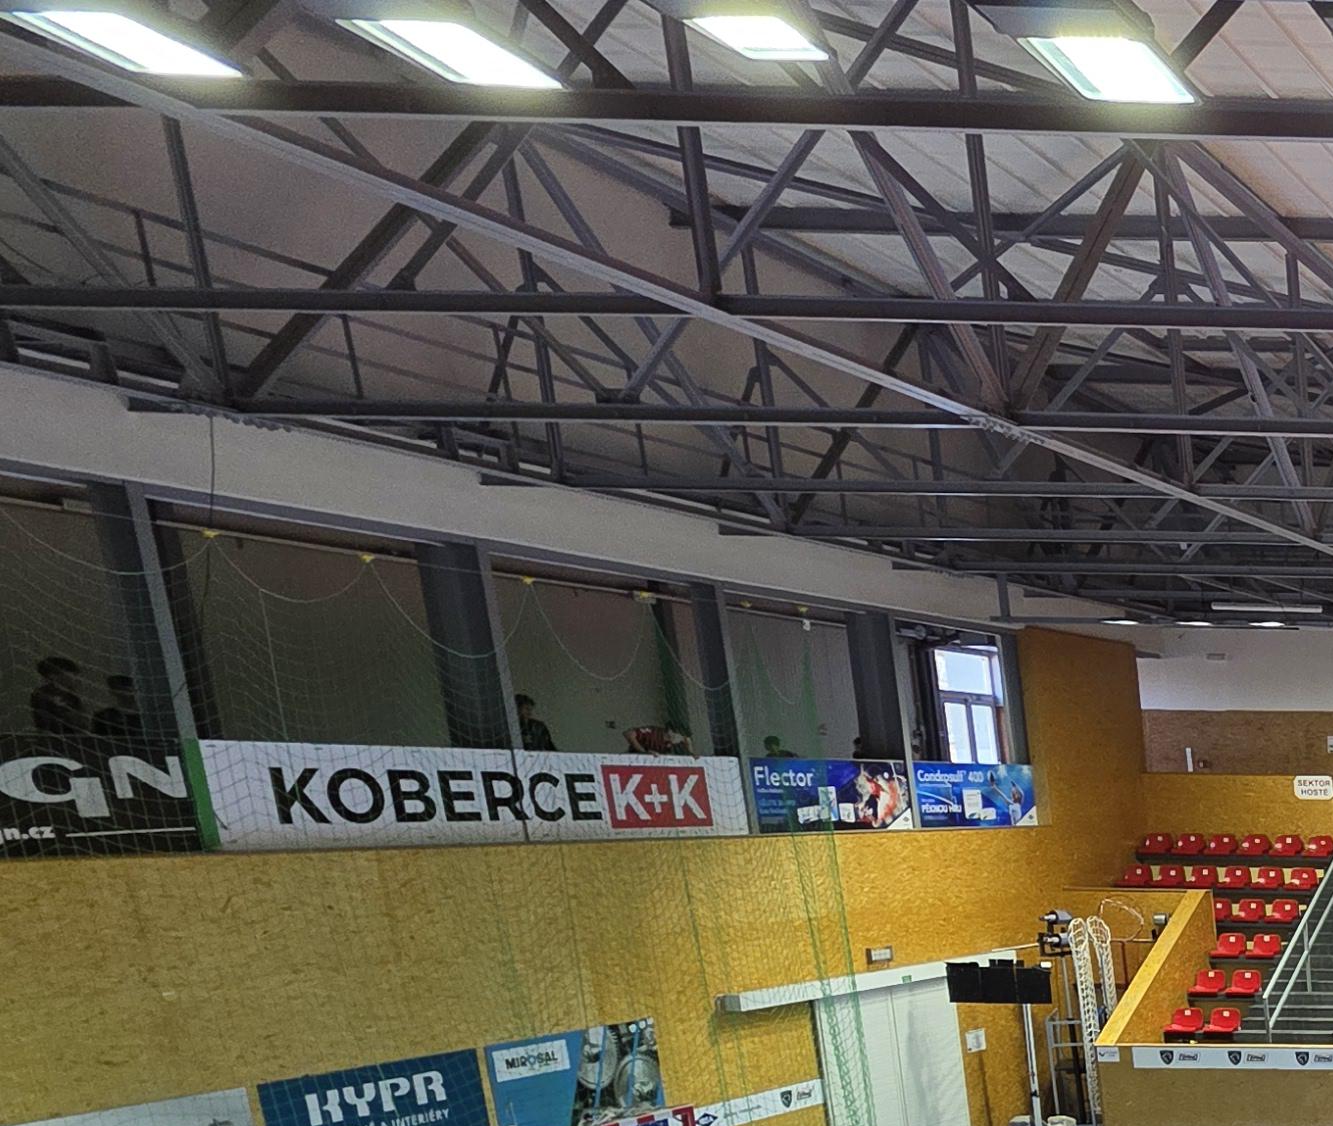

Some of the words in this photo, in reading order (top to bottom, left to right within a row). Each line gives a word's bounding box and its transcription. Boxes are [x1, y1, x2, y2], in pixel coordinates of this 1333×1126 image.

[269, 766, 603, 825] KOBERCE
[609, 771, 708, 822] K+K
[754, 766, 814, 787] Flector
[304, 1070, 447, 1126] KYPR
